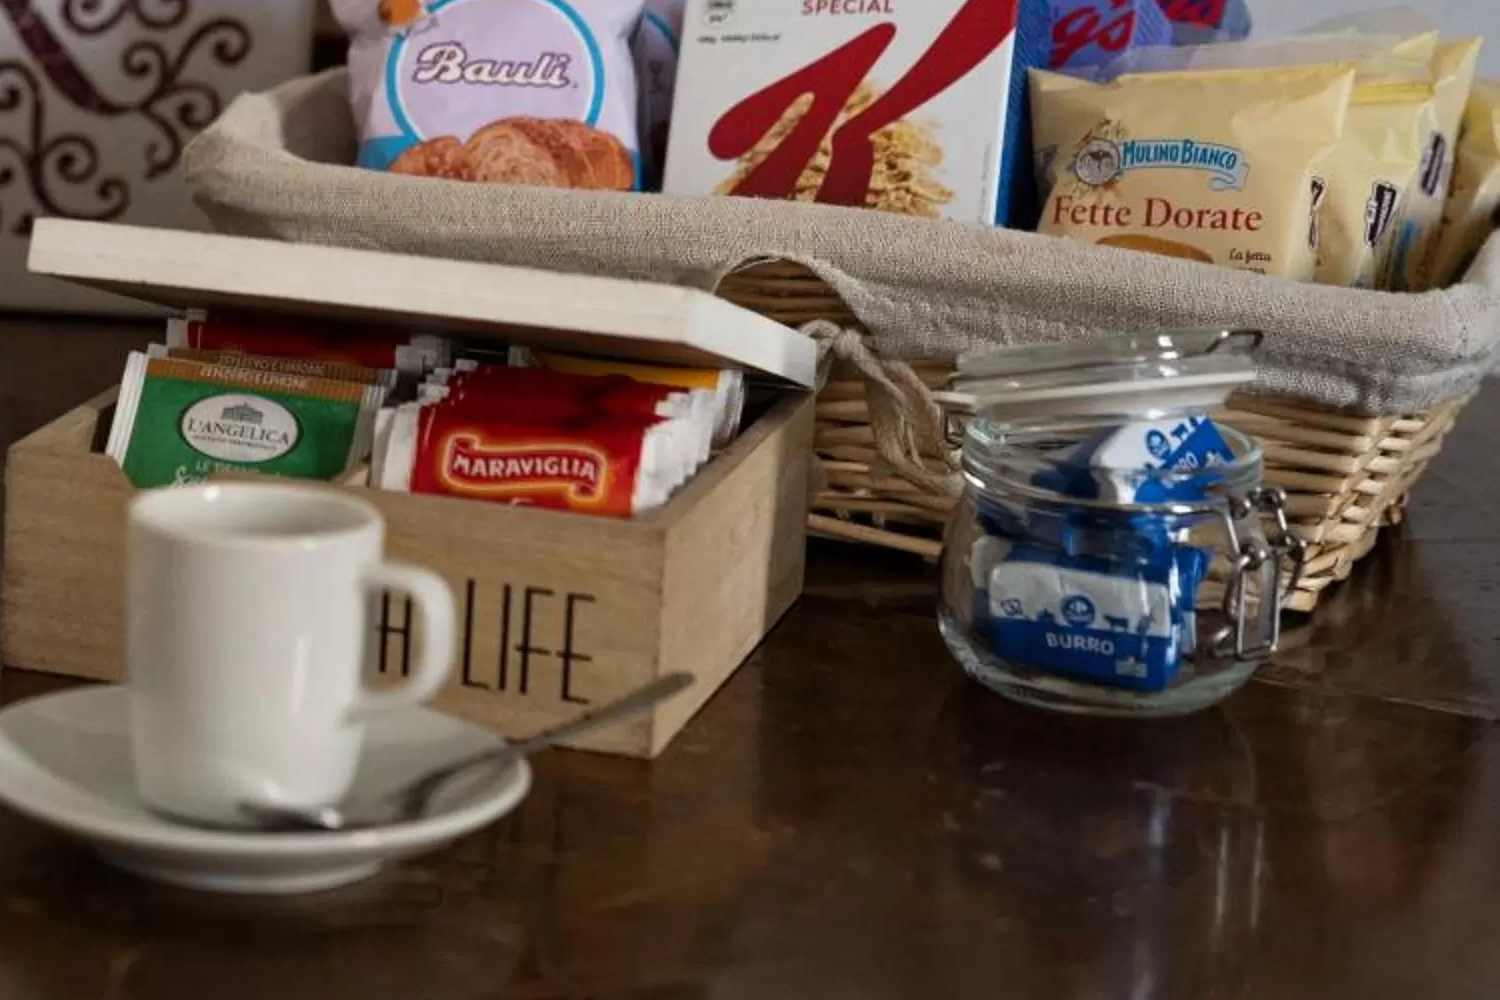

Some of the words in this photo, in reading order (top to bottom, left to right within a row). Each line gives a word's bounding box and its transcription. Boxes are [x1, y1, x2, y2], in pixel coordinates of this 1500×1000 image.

[411, 40, 571, 89] Bauli
[1122, 139, 1180, 166] MULINO
[1181, 138, 1238, 170] BIANCO
[1052, 194, 1132, 226] Fette
[1143, 197, 1263, 231] Dorate
[187, 416, 289, 446] L'ANGELICA
[452, 453, 599, 481] MARAVIGLIA
[462, 578, 597, 706] LIFE
[1046, 631, 1116, 657] BURRO
